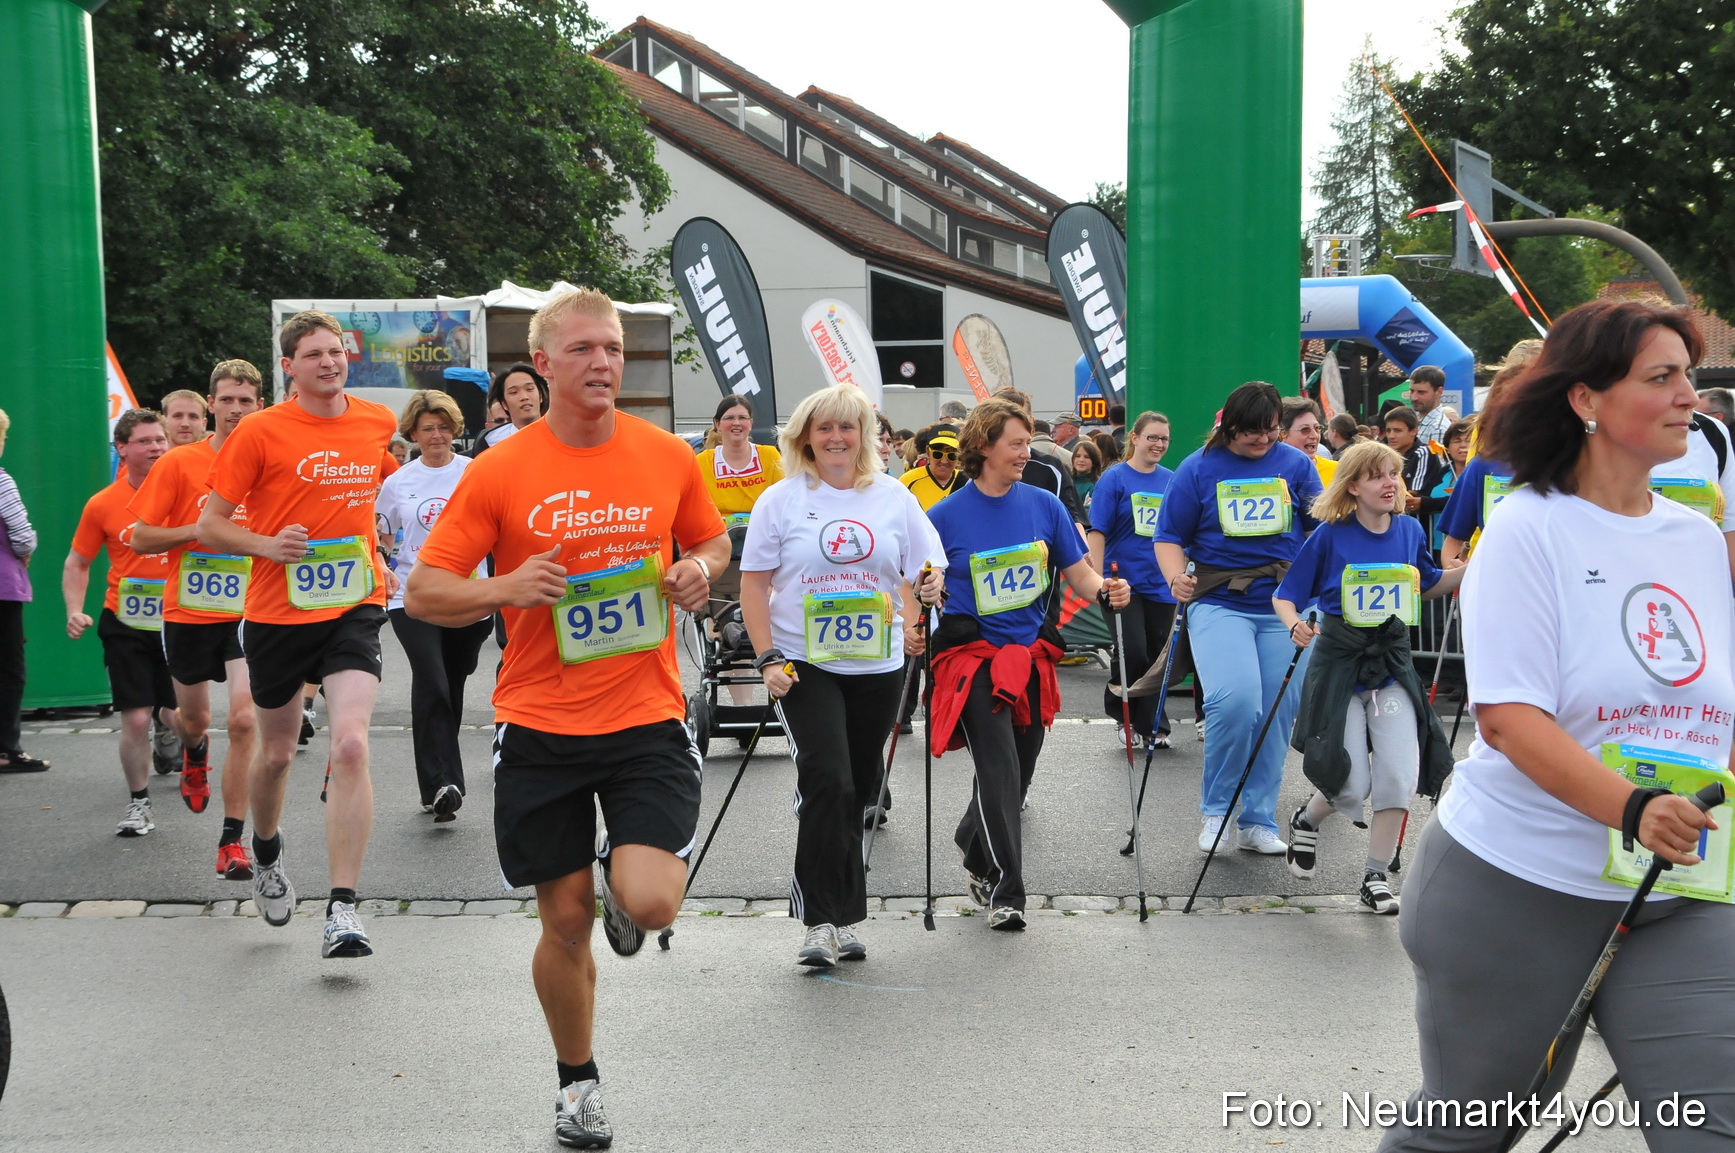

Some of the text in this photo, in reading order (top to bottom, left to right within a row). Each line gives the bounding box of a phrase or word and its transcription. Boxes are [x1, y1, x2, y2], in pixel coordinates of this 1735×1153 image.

[370, 341, 453, 367] Logistics
[412, 363, 424, 371] for
[1081, 400, 1106, 418] 00
[313, 461, 376, 478] Fischer
[319, 477, 373, 486] AUTOMOBILE
[716, 477, 766, 489] MAX BÖGL
[552, 503, 654, 531] Fischer
[1227, 497, 1276, 521] 122
[562, 523, 647, 541] AUTOMOBILE
[579, 546, 600, 560] und
[604, 542, 624, 554] das
[187, 571, 240, 599] 968
[296, 560, 356, 592] 997
[801, 571, 880, 584] LAUFEN MIT HER
[983, 565, 1036, 597] 142
[309, 591, 329, 599] David
[821, 585, 839, 593] Heck
[1352, 584, 1400, 610] 121
[567, 592, 645, 640] 951
[814, 614, 874, 643] 785
[584, 636, 615, 648] Martin
[1597, 703, 1732, 727] LAUFEN MIT HERZ
[1664, 729, 1683, 740] Dr.
[1687, 730, 1719, 746] Rösch
[1626, 773, 1674, 789] firmenlauf
